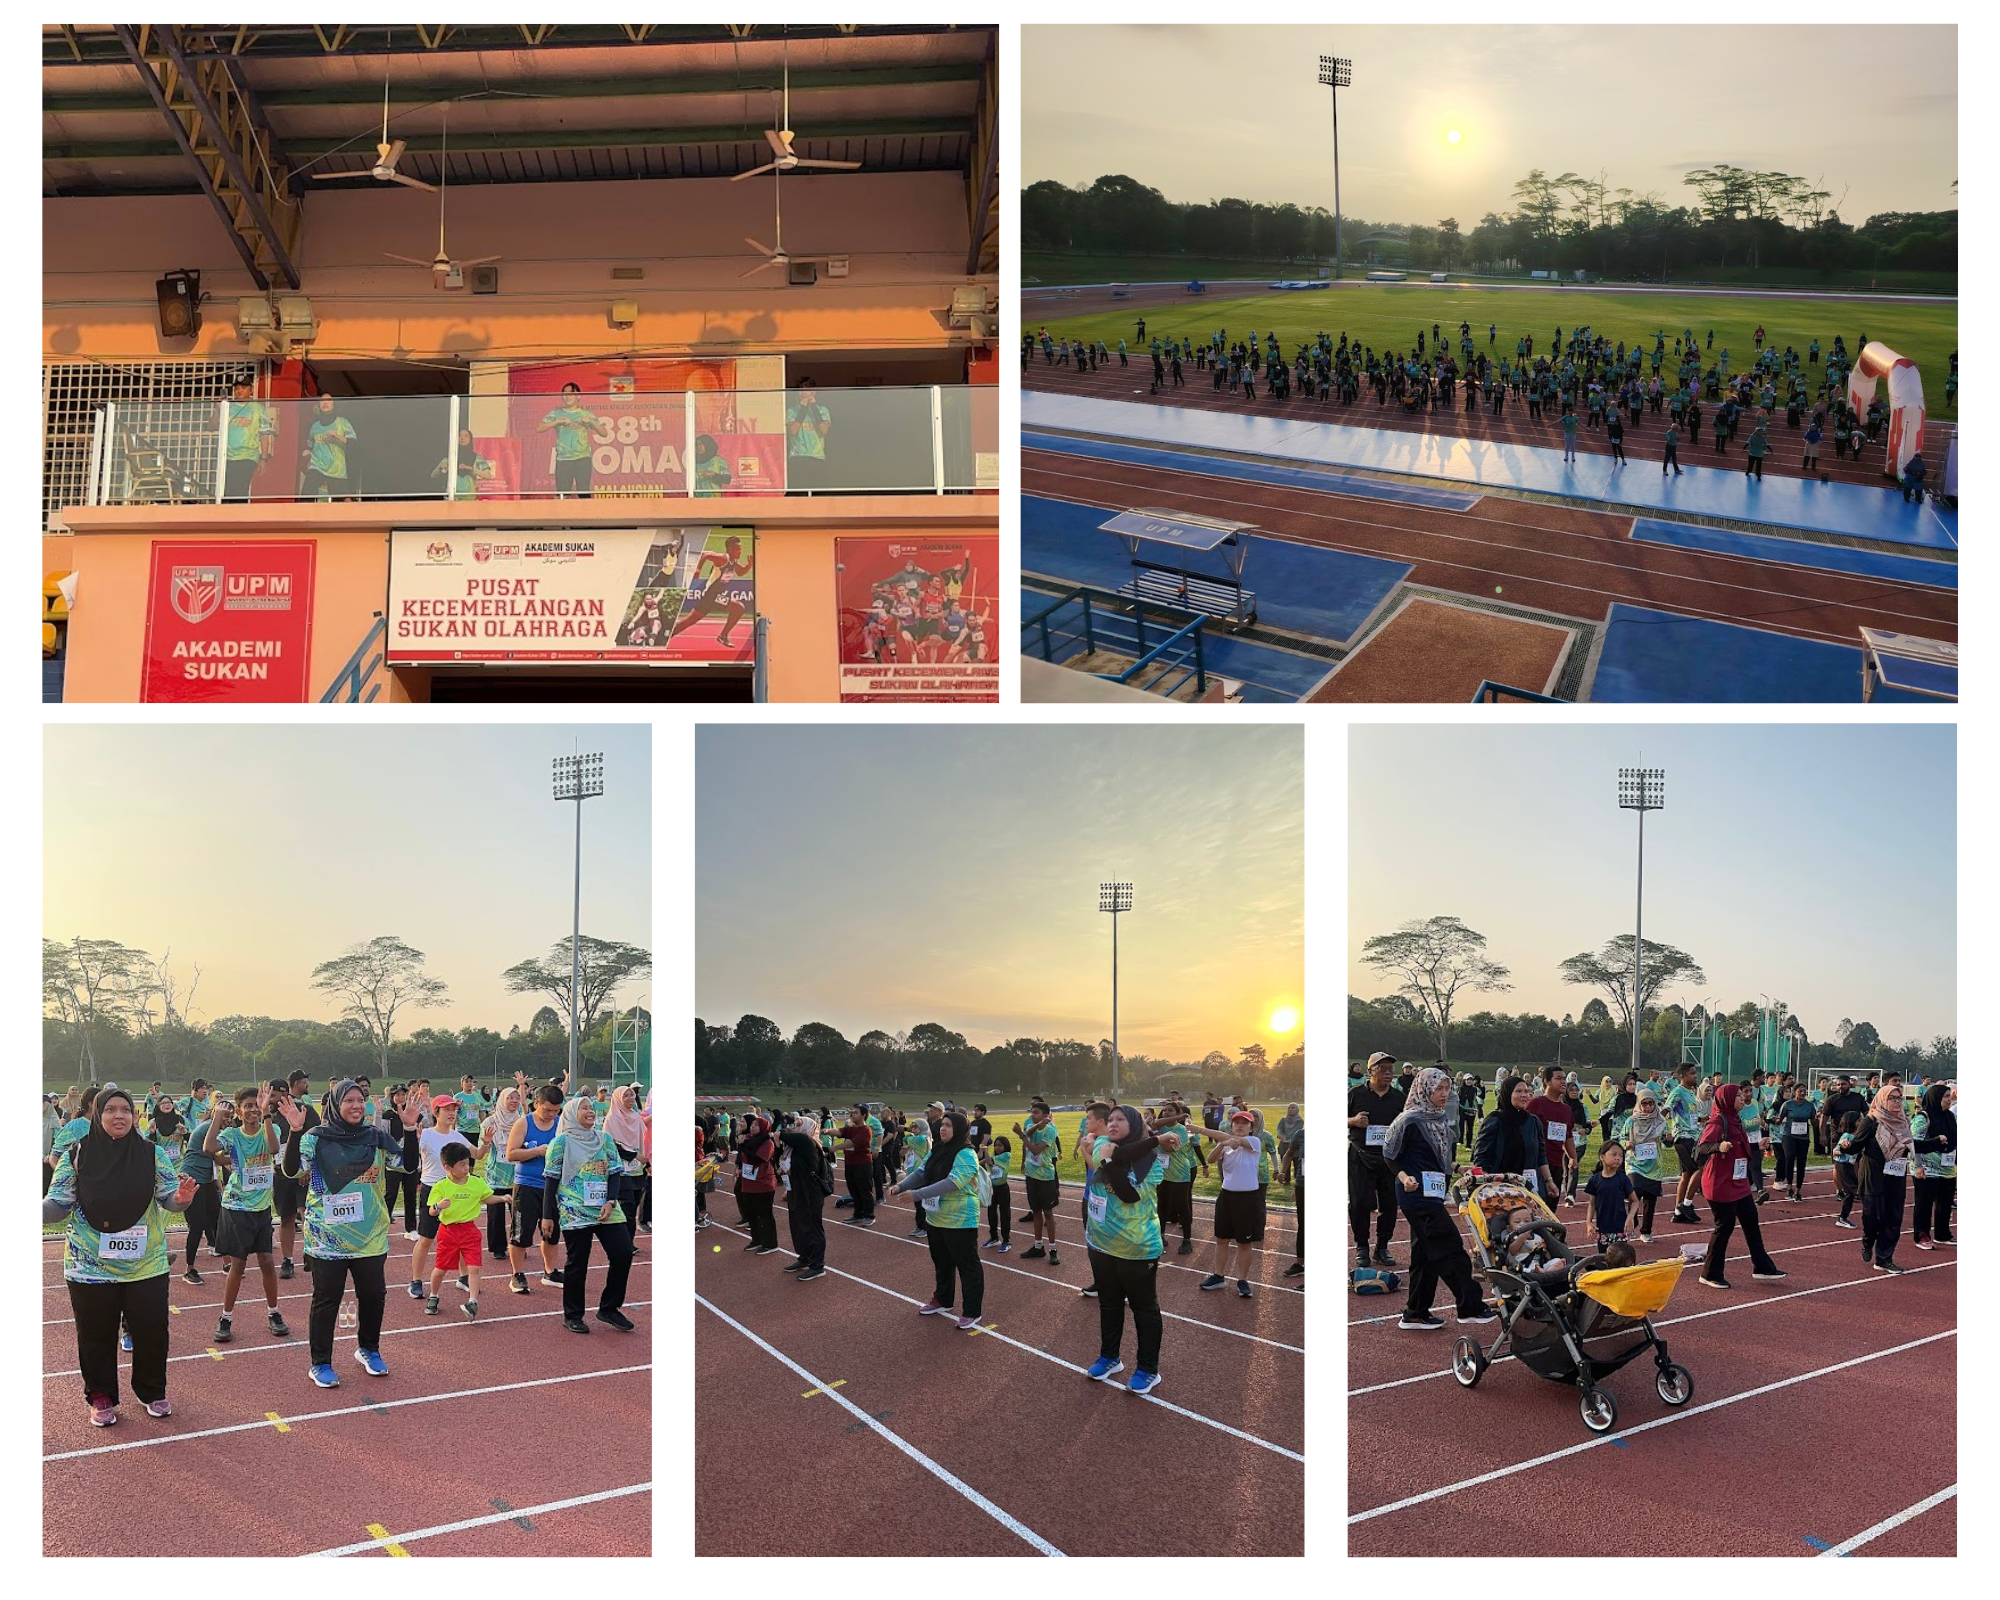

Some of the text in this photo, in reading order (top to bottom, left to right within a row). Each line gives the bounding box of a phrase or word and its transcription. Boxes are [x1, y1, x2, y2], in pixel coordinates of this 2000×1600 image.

[592, 415, 662, 445] 38th
[1146, 524, 1184, 537] UPM
[494, 546, 519, 554] UPM
[525, 543, 594, 552] AKADEMI SUKAN
[228, 576, 290, 594] UPM
[466, 579, 540, 596] PUSAT
[402, 600, 604, 616] KECEMERLANGAN
[398, 620, 608, 638] SUKAN OLAHRAGA
[172, 641, 282, 658] AKADEMI
[184, 662, 268, 680] SUKAN
[842, 668, 891, 677] PUSAT
[869, 680, 918, 690] SUKAN
[332, 1206, 355, 1216] 0011
[109, 1240, 138, 1250] 0035
